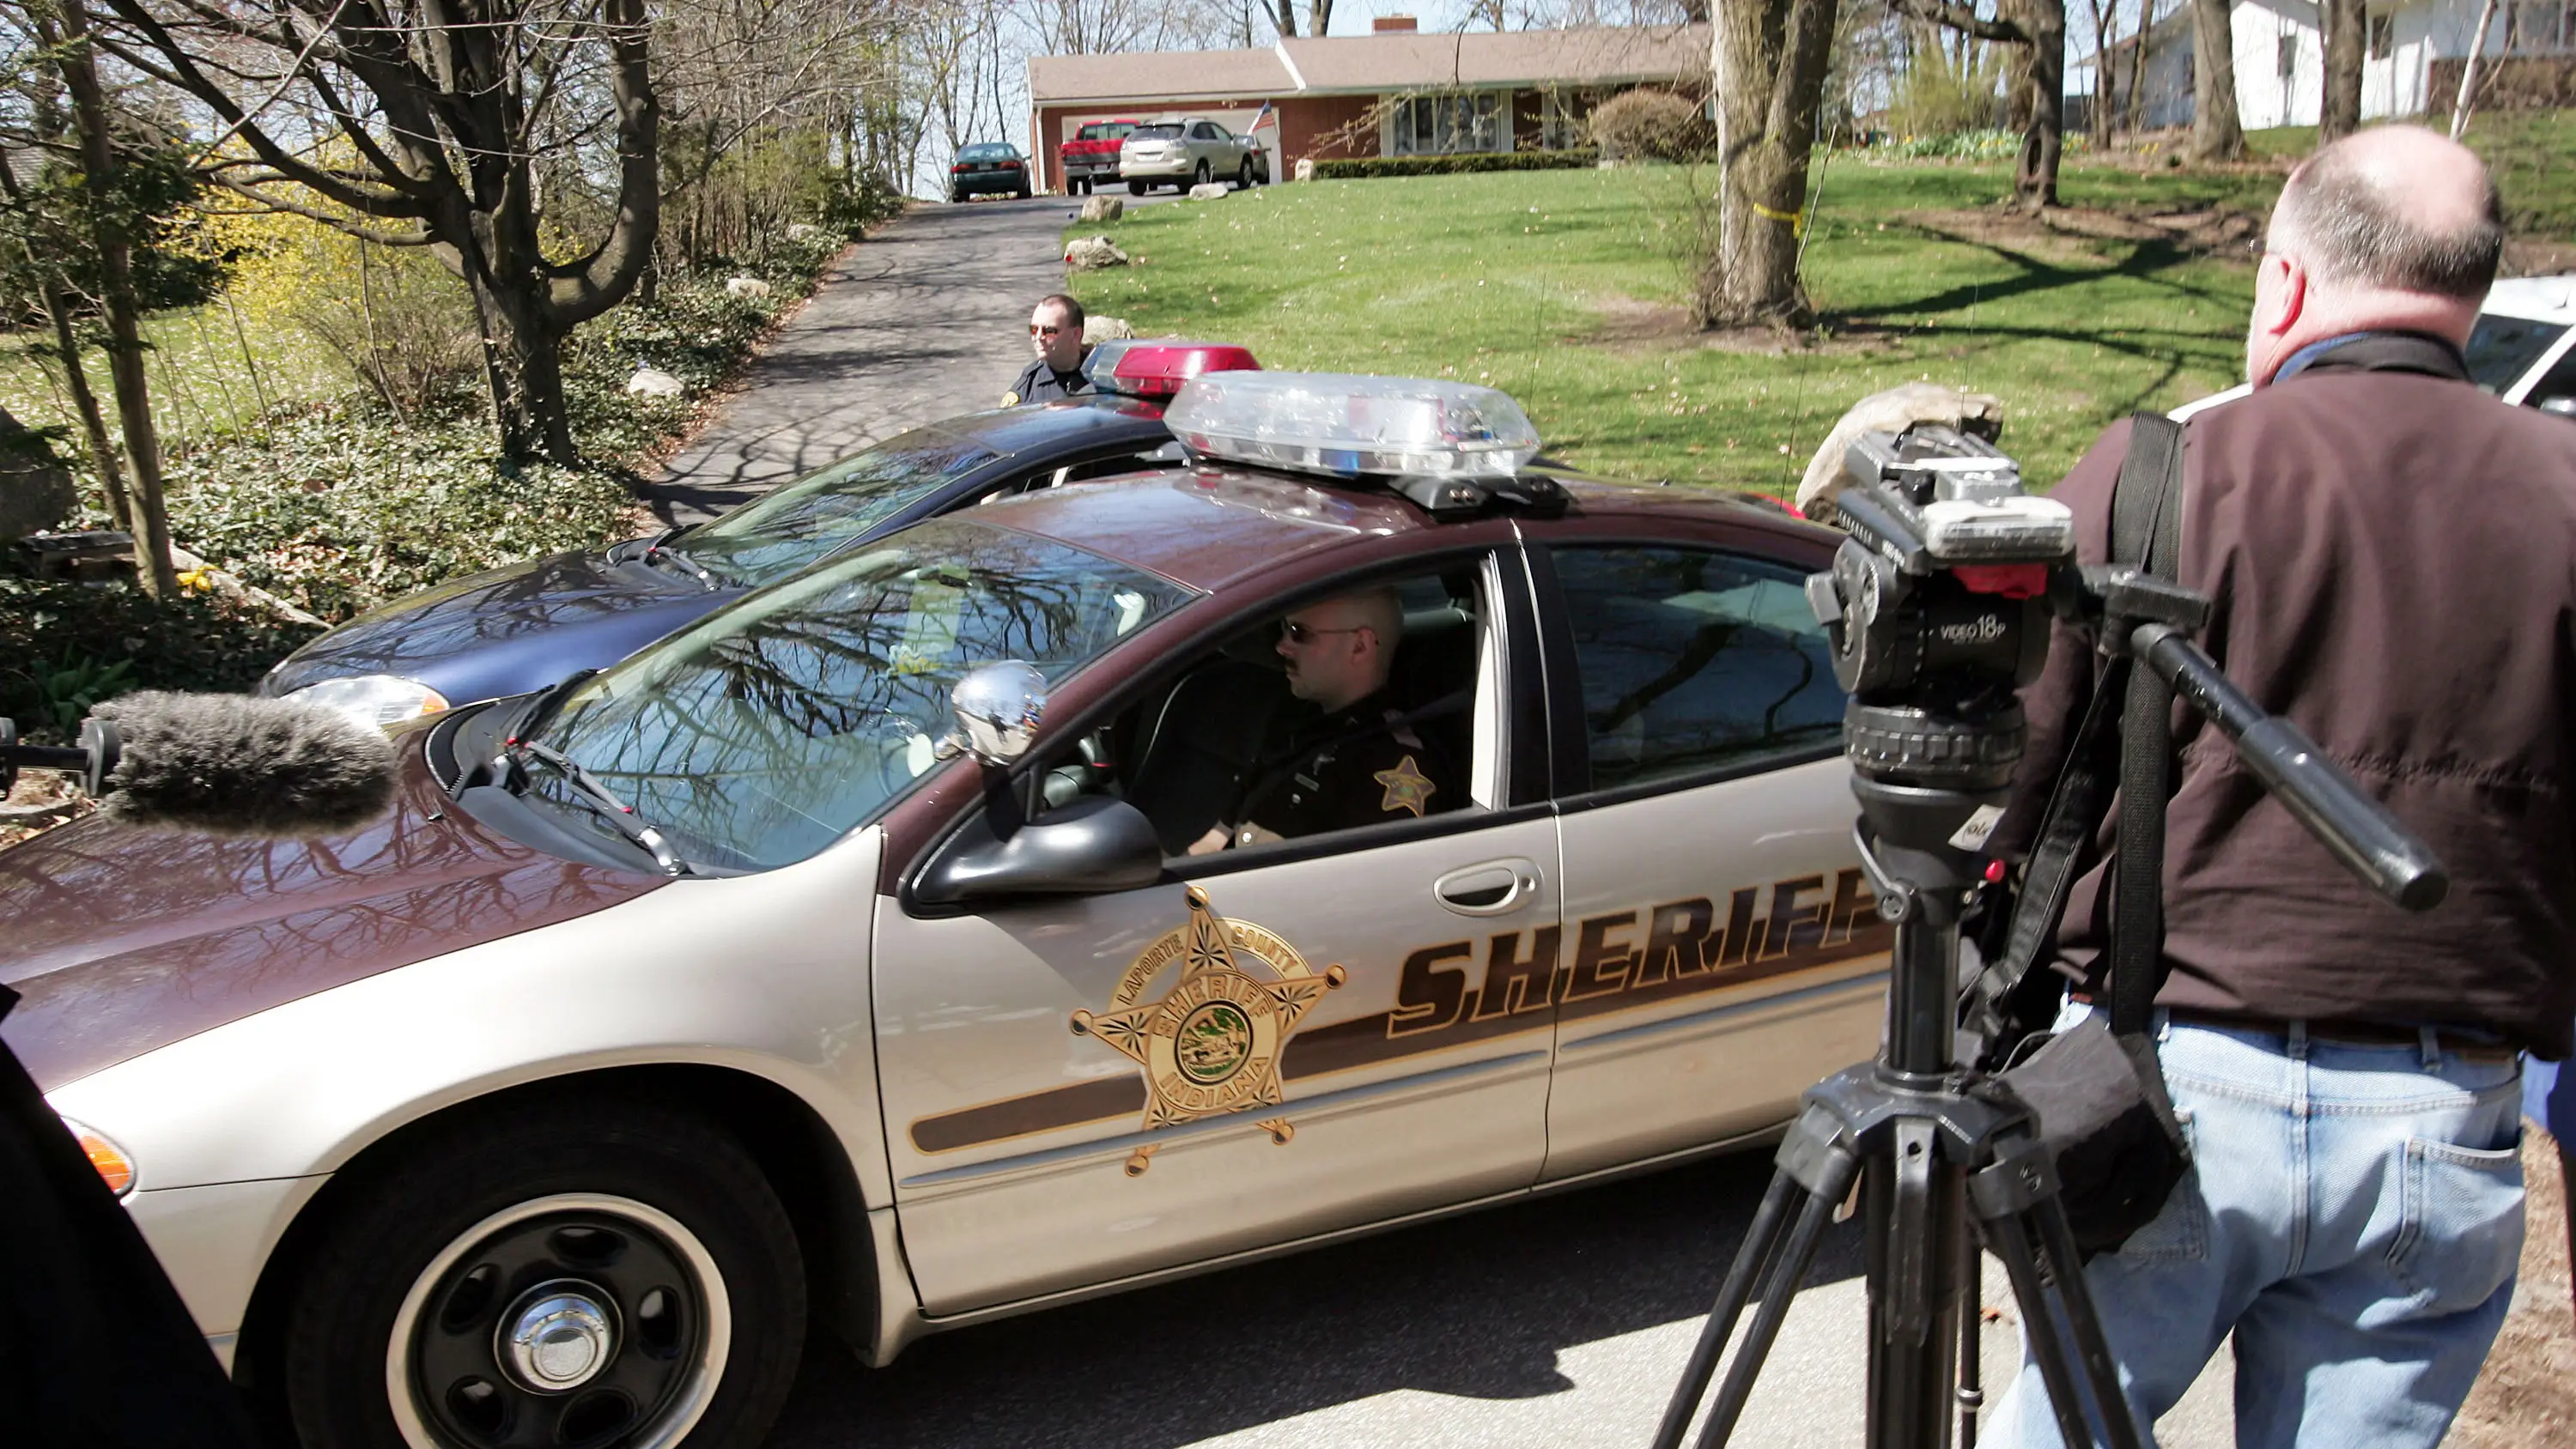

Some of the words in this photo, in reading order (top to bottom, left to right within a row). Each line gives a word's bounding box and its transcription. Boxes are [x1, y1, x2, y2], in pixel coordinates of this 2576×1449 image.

[1117, 933, 1184, 1006] LAPORTE
[1230, 926, 1298, 972] COUNTY
[1153, 974, 1272, 1039] SHERIFF
[1160, 1057, 1270, 1108] INDIANA
